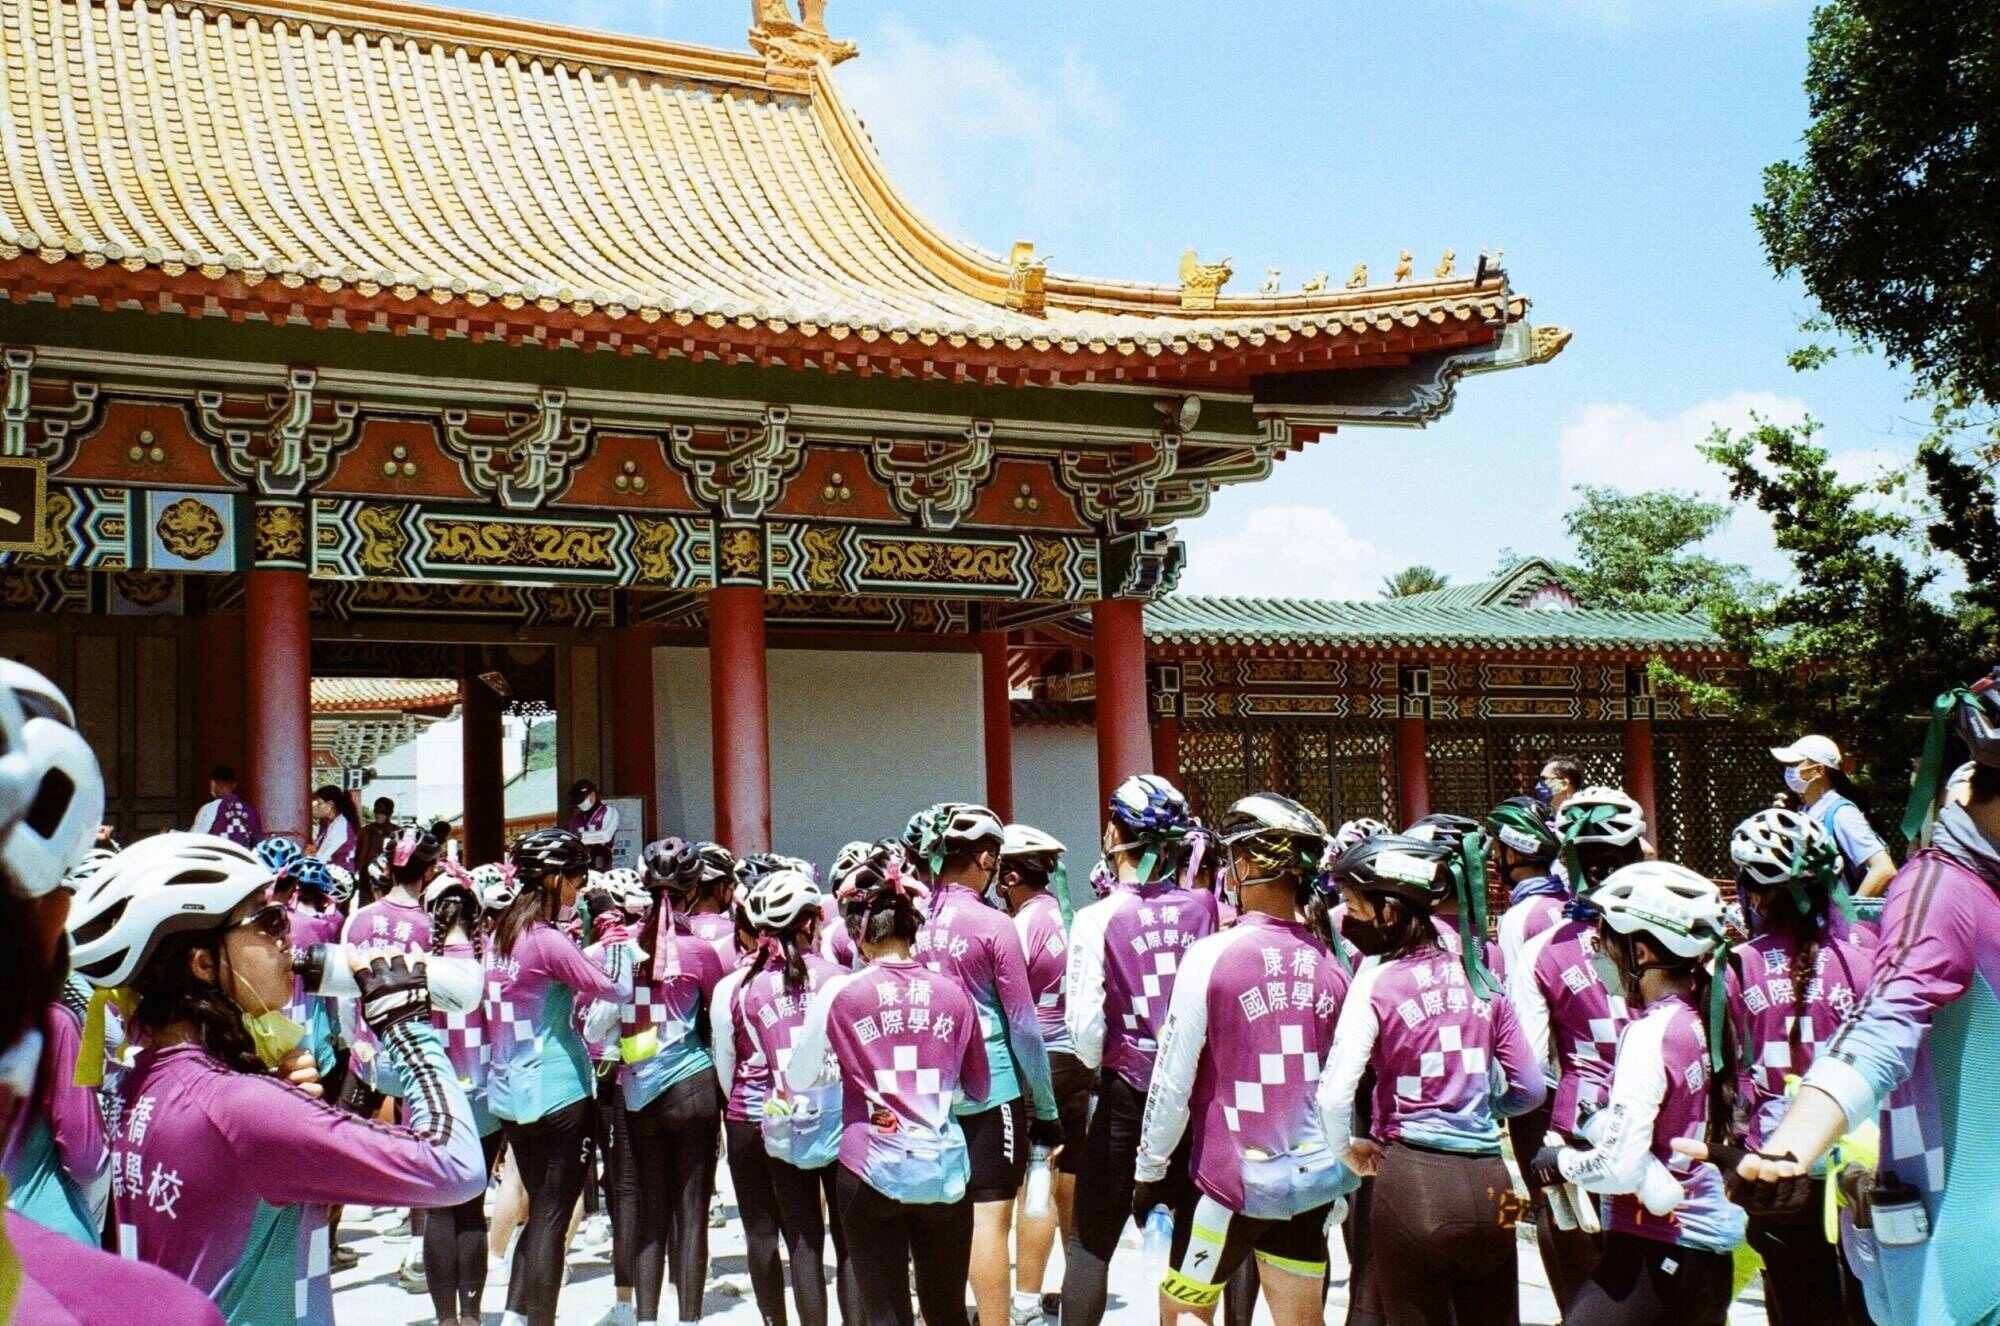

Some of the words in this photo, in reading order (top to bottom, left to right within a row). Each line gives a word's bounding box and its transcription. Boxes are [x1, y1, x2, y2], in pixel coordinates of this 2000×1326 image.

[1261, 947, 1318, 980] 康橋
[875, 979, 933, 1006] 康橋
[1238, 981, 1335, 1023] 國際學校
[852, 1008, 955, 1046] 國際學校
[1001, 1103, 1014, 1165] GIANT
